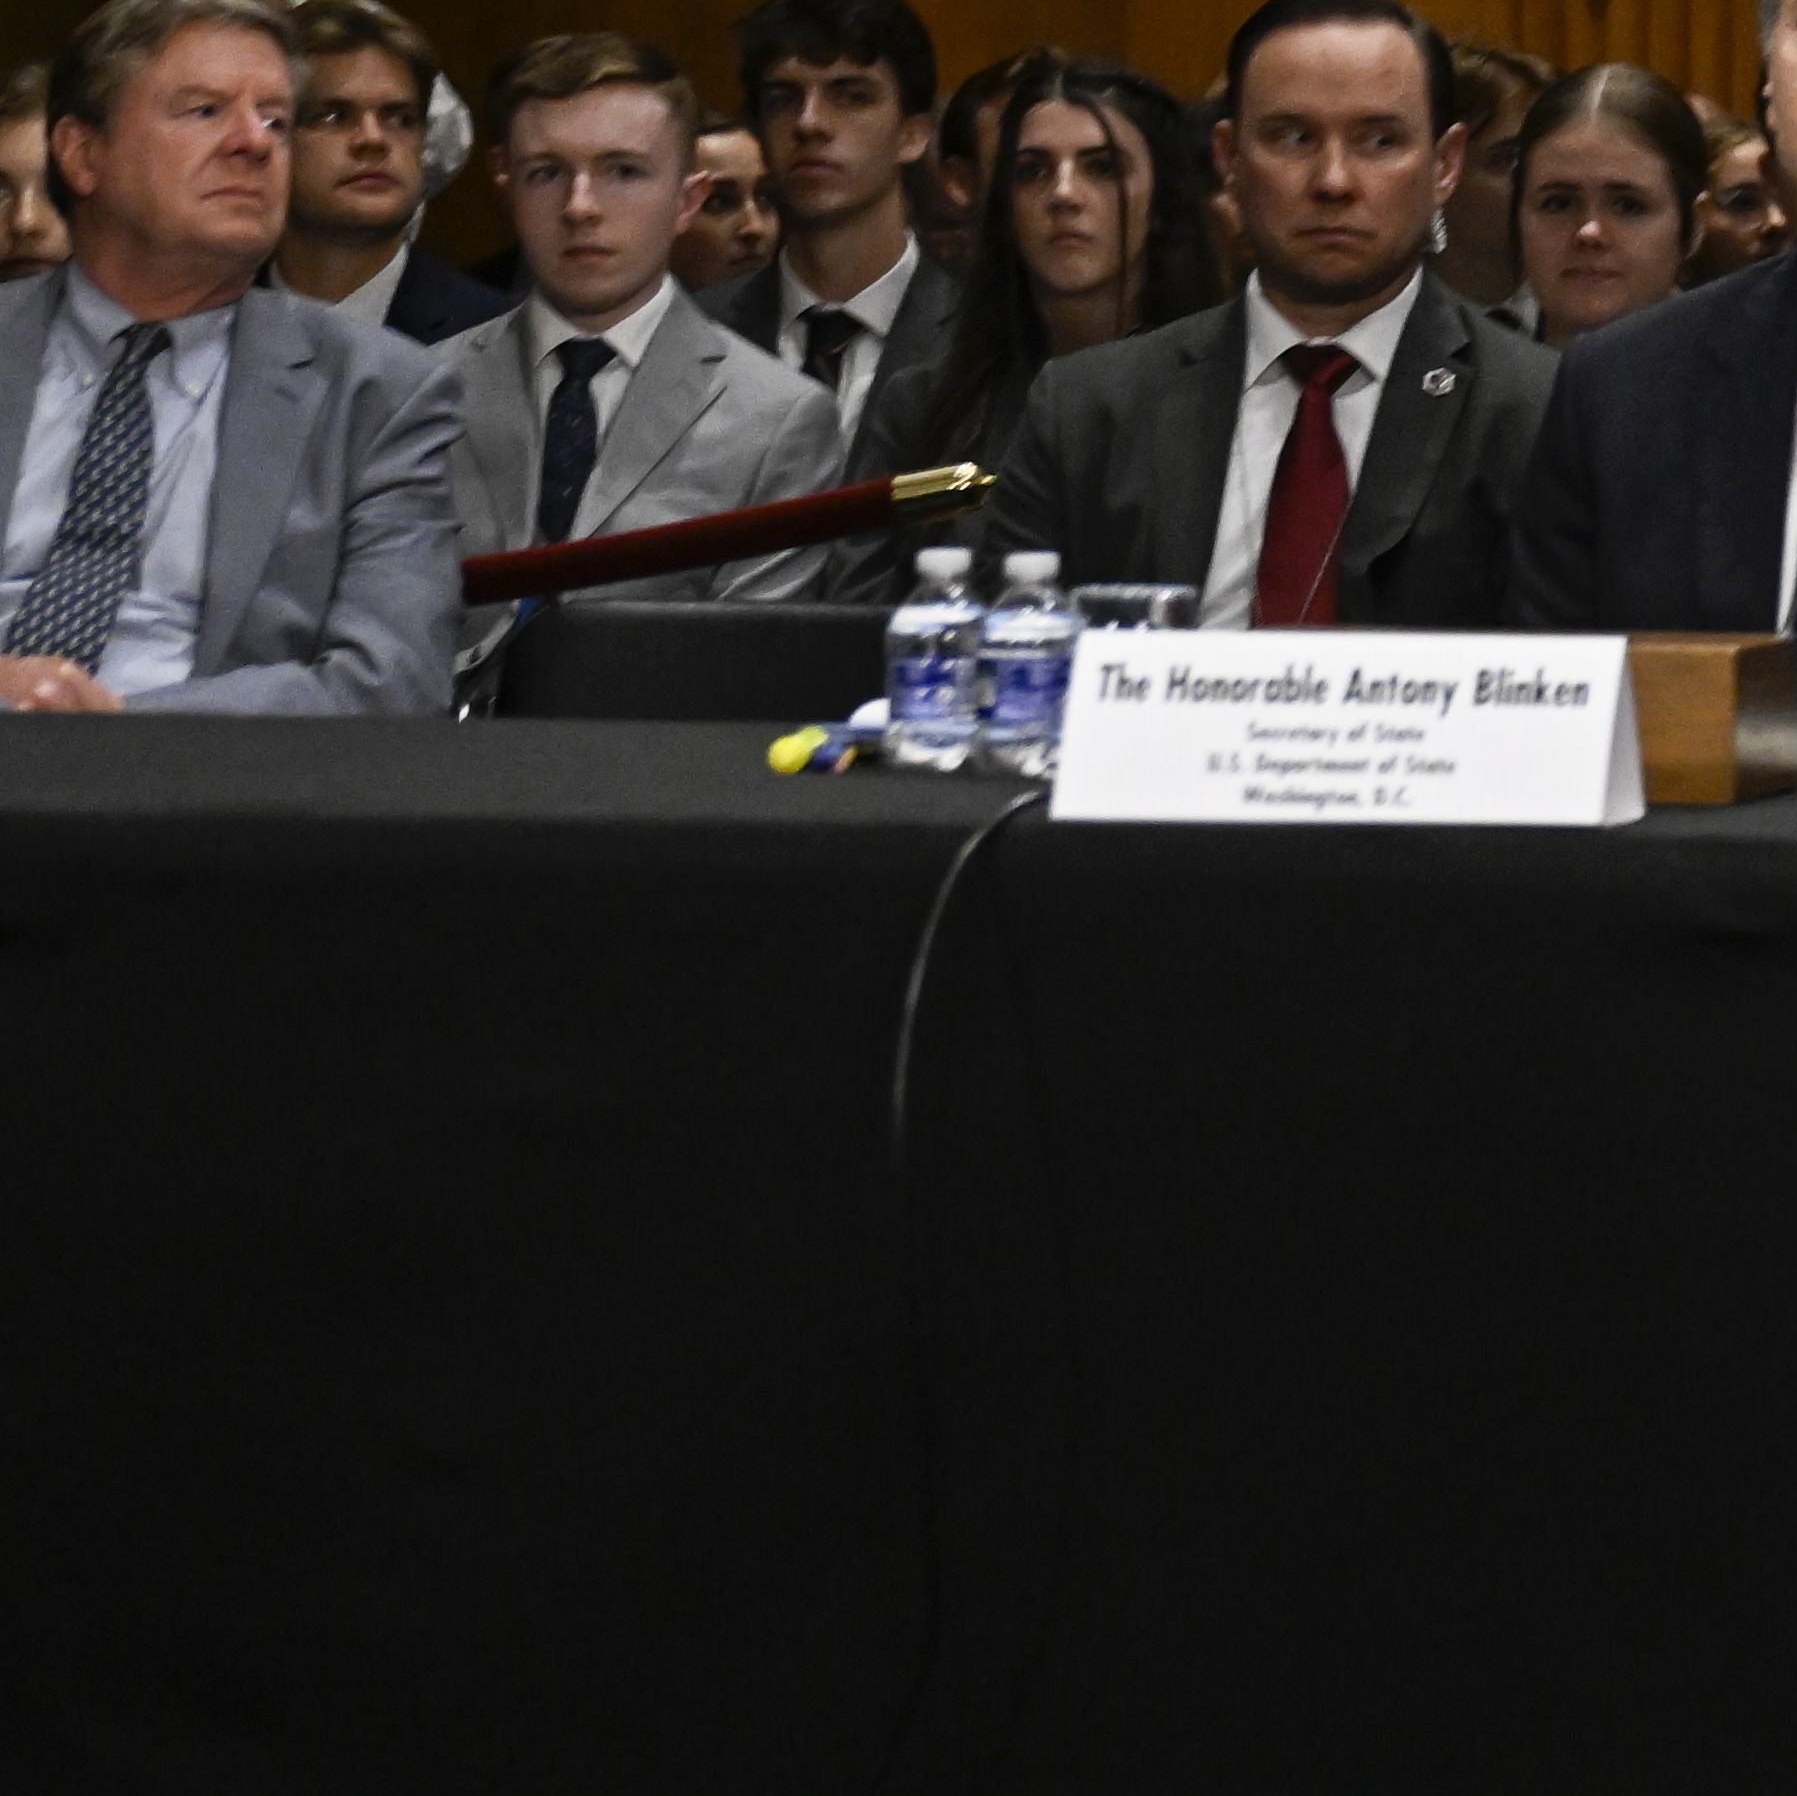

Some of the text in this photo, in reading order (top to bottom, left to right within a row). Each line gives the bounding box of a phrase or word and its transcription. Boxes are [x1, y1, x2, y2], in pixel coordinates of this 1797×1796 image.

[1099, 662, 1151, 704] The
[1165, 664, 1328, 706] Honorable
[1342, 667, 1459, 717] Antony
[1472, 667, 1591, 708] Blinken
[1347, 720, 1369, 742] of
[1375, 722, 1426, 743] State
[1376, 755, 1399, 775] of
[1405, 754, 1456, 775] State
